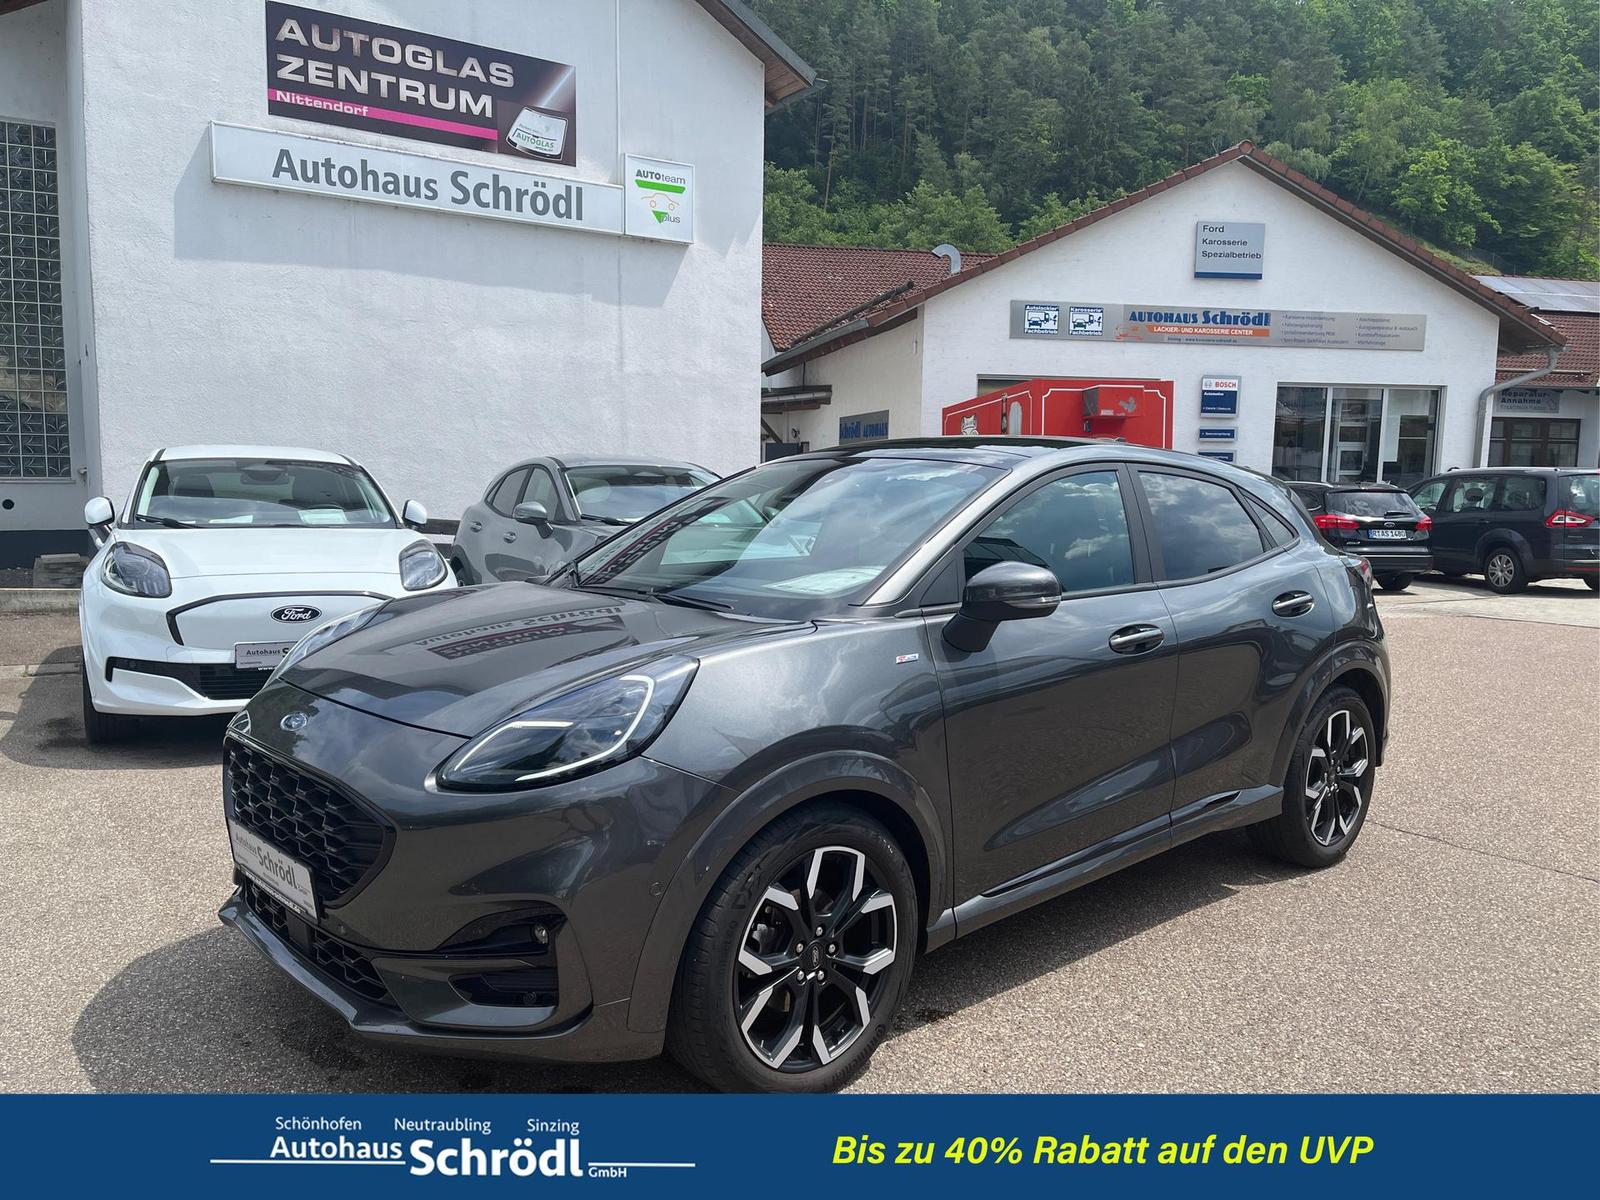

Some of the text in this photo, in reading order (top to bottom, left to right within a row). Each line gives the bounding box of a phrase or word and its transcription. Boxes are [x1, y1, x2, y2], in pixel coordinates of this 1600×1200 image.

[276, 18, 514, 88] AUTOGLAS
[276, 54, 493, 118] ZENTRUM
[276, 91, 369, 117] Nittendorf
[516, 132, 554, 149] AUTOGLAS
[272, 148, 584, 221] Autohaus Schrödl
[636, 169, 686, 184] AUTOteam
[1202, 225, 1225, 233] Ford
[1202, 238, 1248, 247] Karosserie
[1202, 251, 1262, 259] Spezialbetrieb
[1129, 311, 1198, 324] AUTOHAUS
[1202, 311, 1271, 326] Schrödl
[281, 607, 312, 620] Ford
[256, 846, 298, 890] Schrödl
